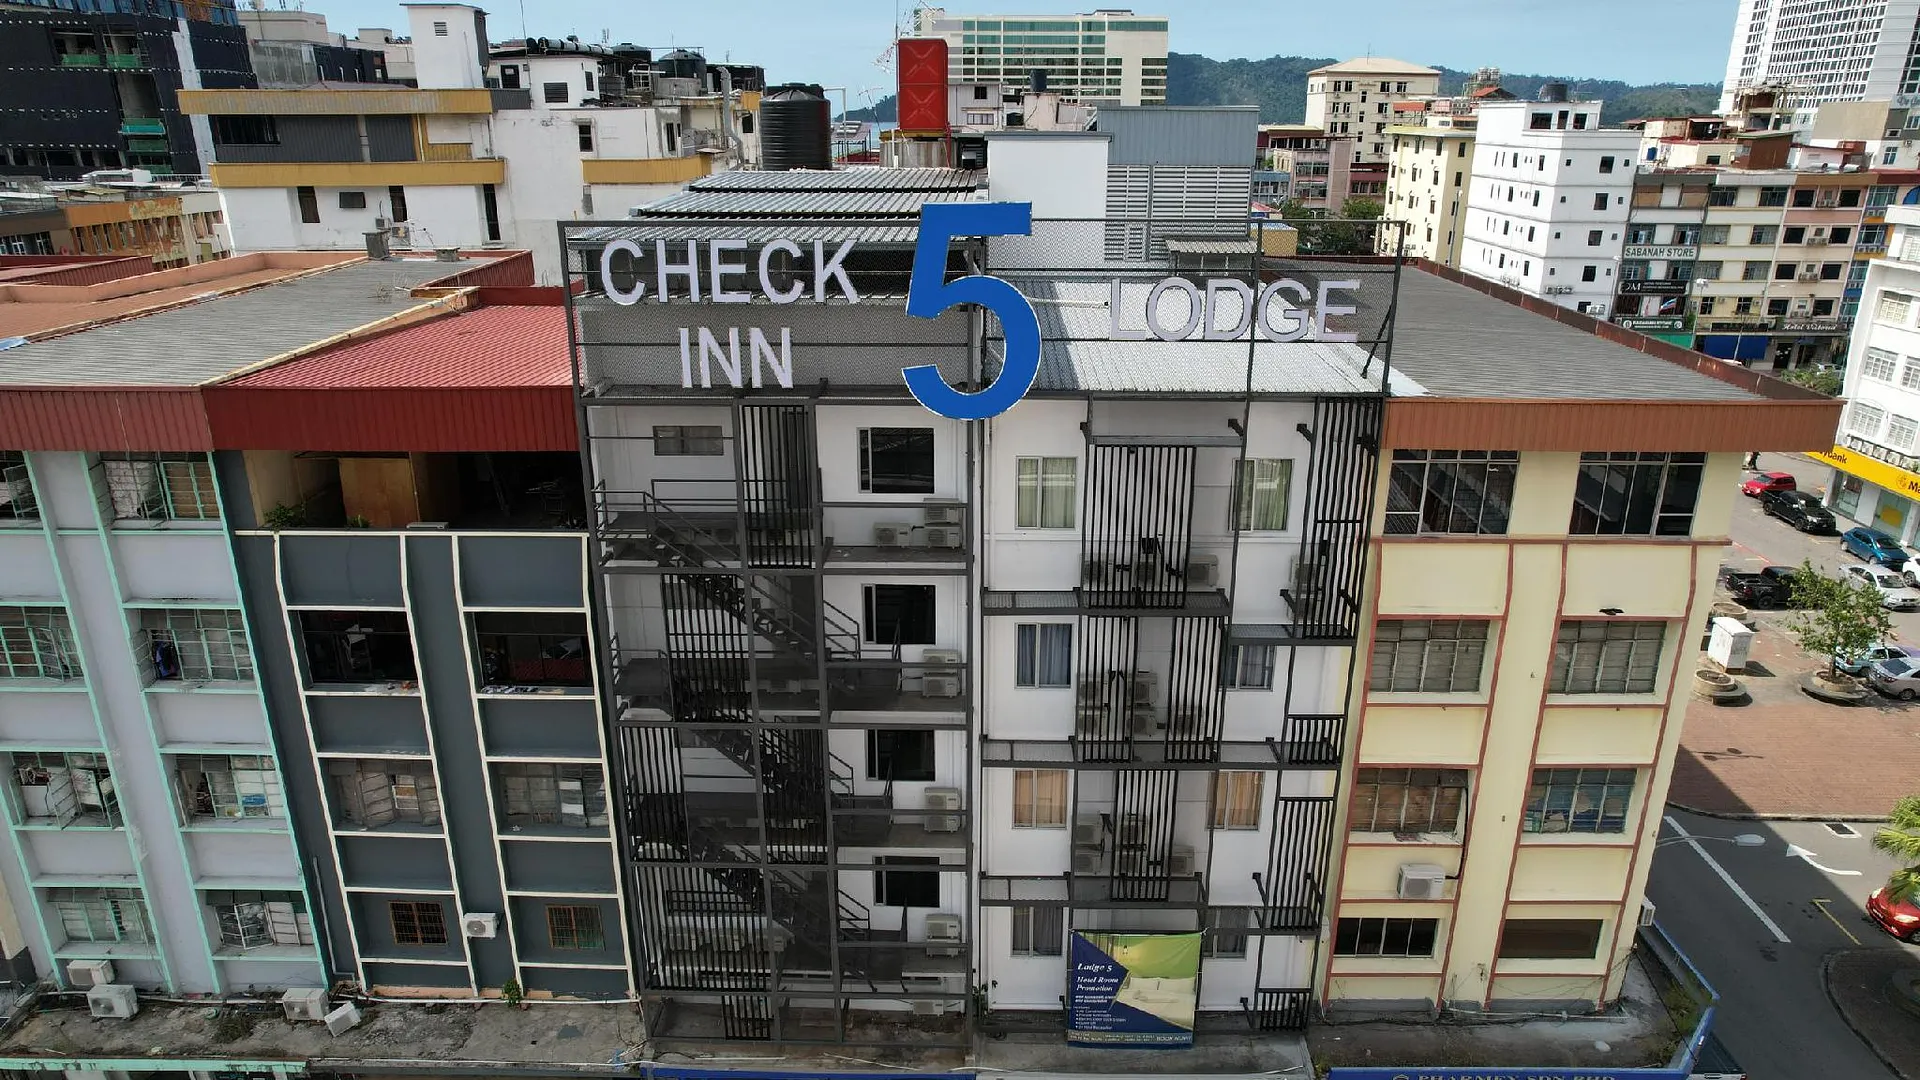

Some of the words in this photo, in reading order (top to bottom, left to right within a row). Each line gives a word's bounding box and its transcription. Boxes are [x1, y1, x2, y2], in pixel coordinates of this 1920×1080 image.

[1625, 247, 1664, 257] SABANAH
[1666, 247, 1694, 257] STORE
[600, 238, 861, 305] CHECK
[901, 201, 1042, 421] 5
[1109, 276, 1361, 342] LODGE
[1782, 323, 1804, 331] Hotel
[678, 326, 794, 389] INN
[1077, 963, 1105, 973] Lodge
